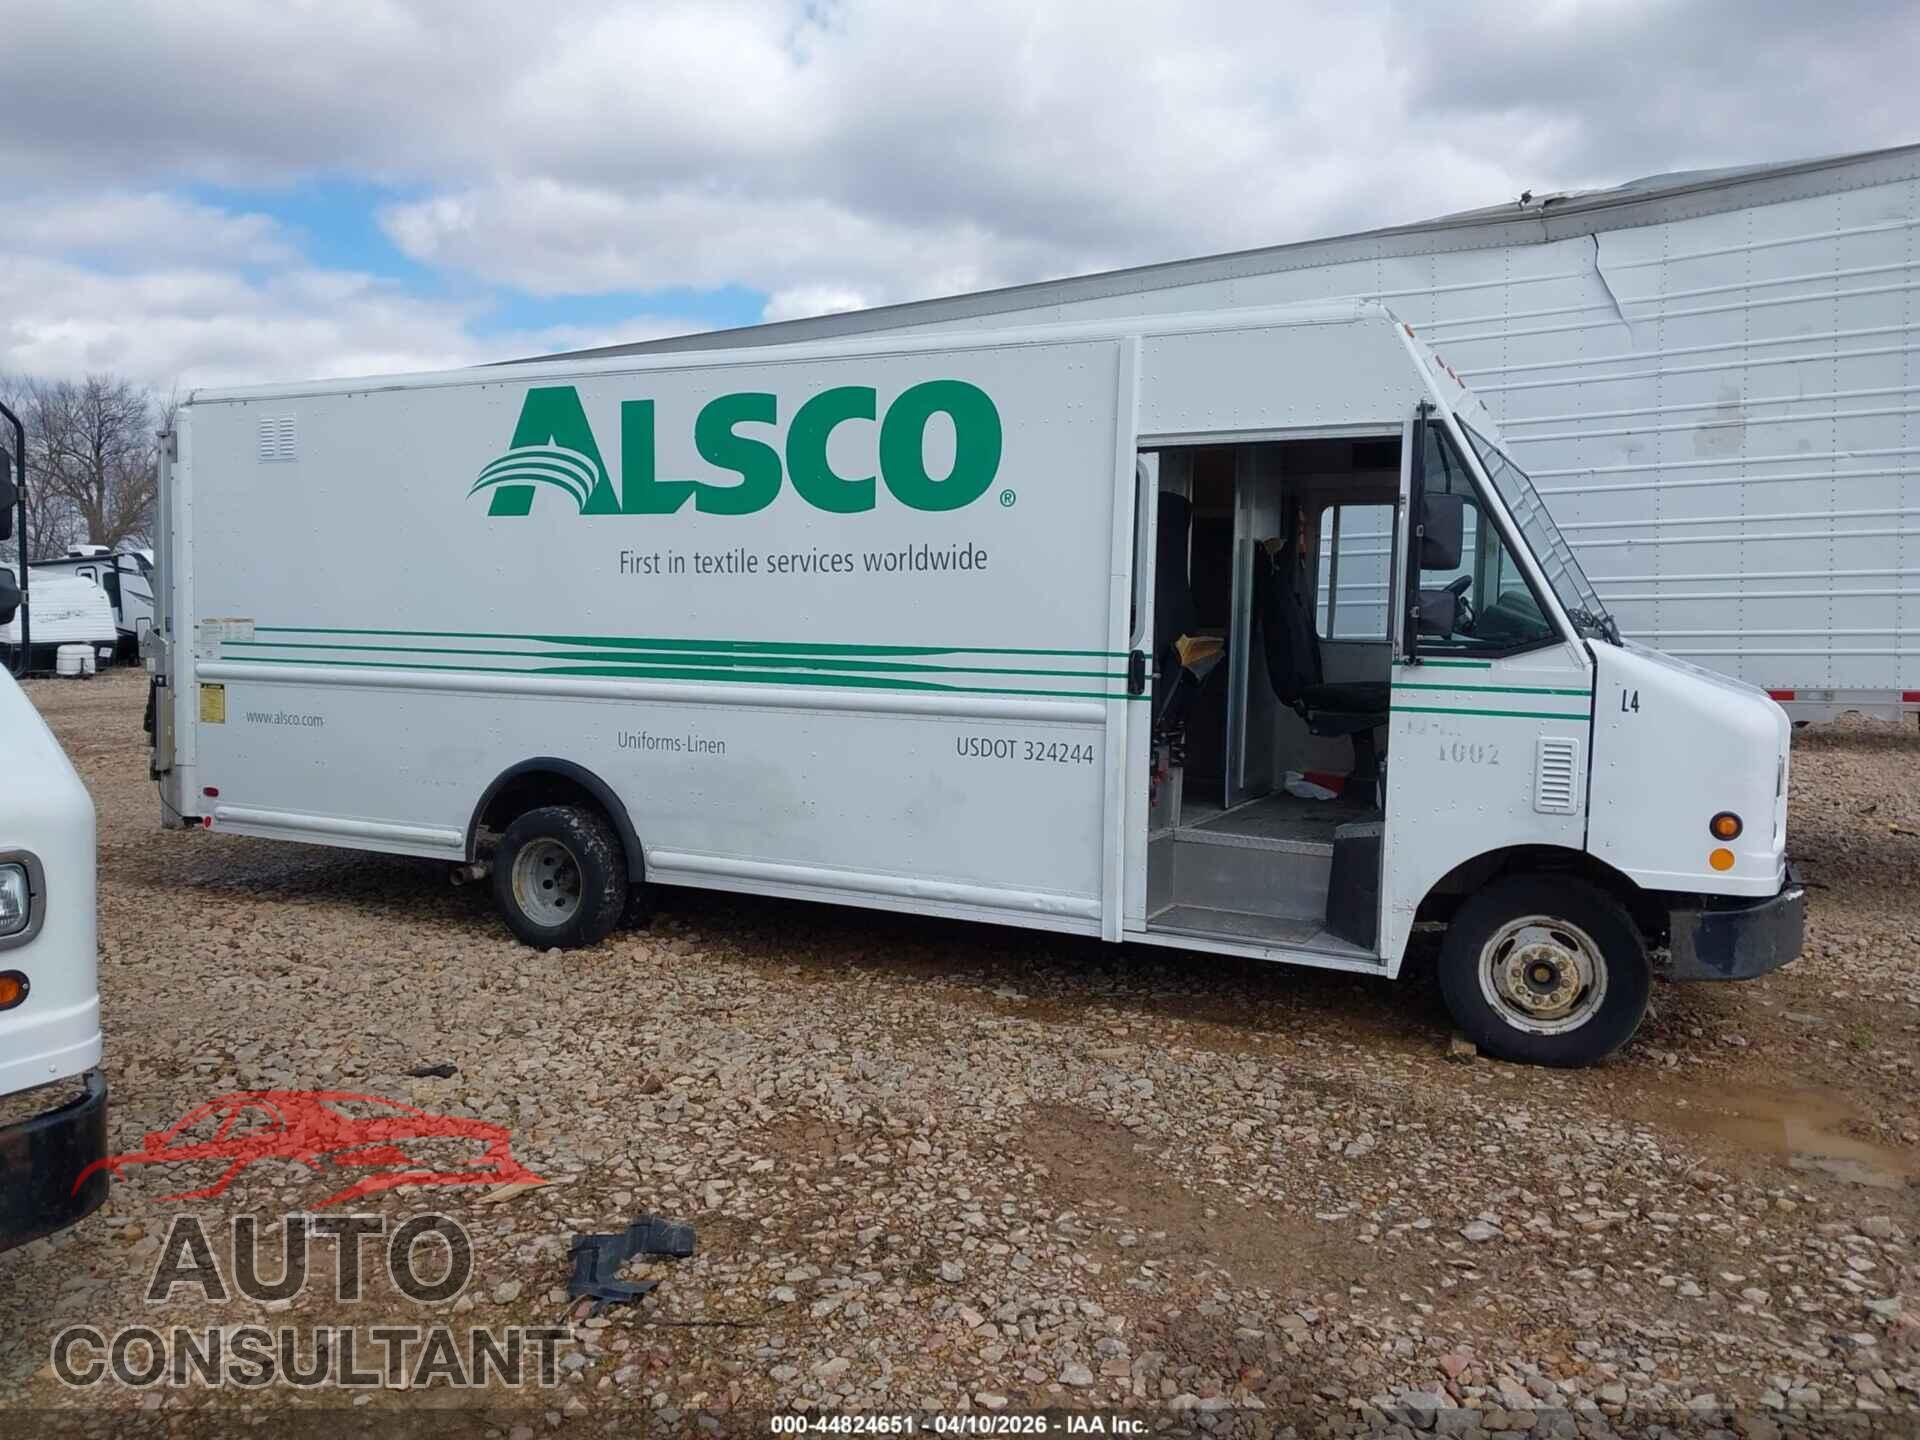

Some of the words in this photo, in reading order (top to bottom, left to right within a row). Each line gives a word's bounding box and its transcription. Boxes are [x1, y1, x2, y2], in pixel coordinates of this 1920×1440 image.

[474, 379, 1003, 516] ALSCO
[619, 550, 661, 575] First
[666, 550, 686, 575] in
[694, 549, 759, 574] textile
[766, 547, 855, 573] services
[863, 543, 989, 572] worldwide
[1621, 689, 1640, 713] L4
[246, 711, 324, 727] www.alsco.com
[617, 732, 726, 754] Uniforms-Linen
[956, 736, 1018, 760] USDOT
[1023, 741, 1095, 765] 324244
